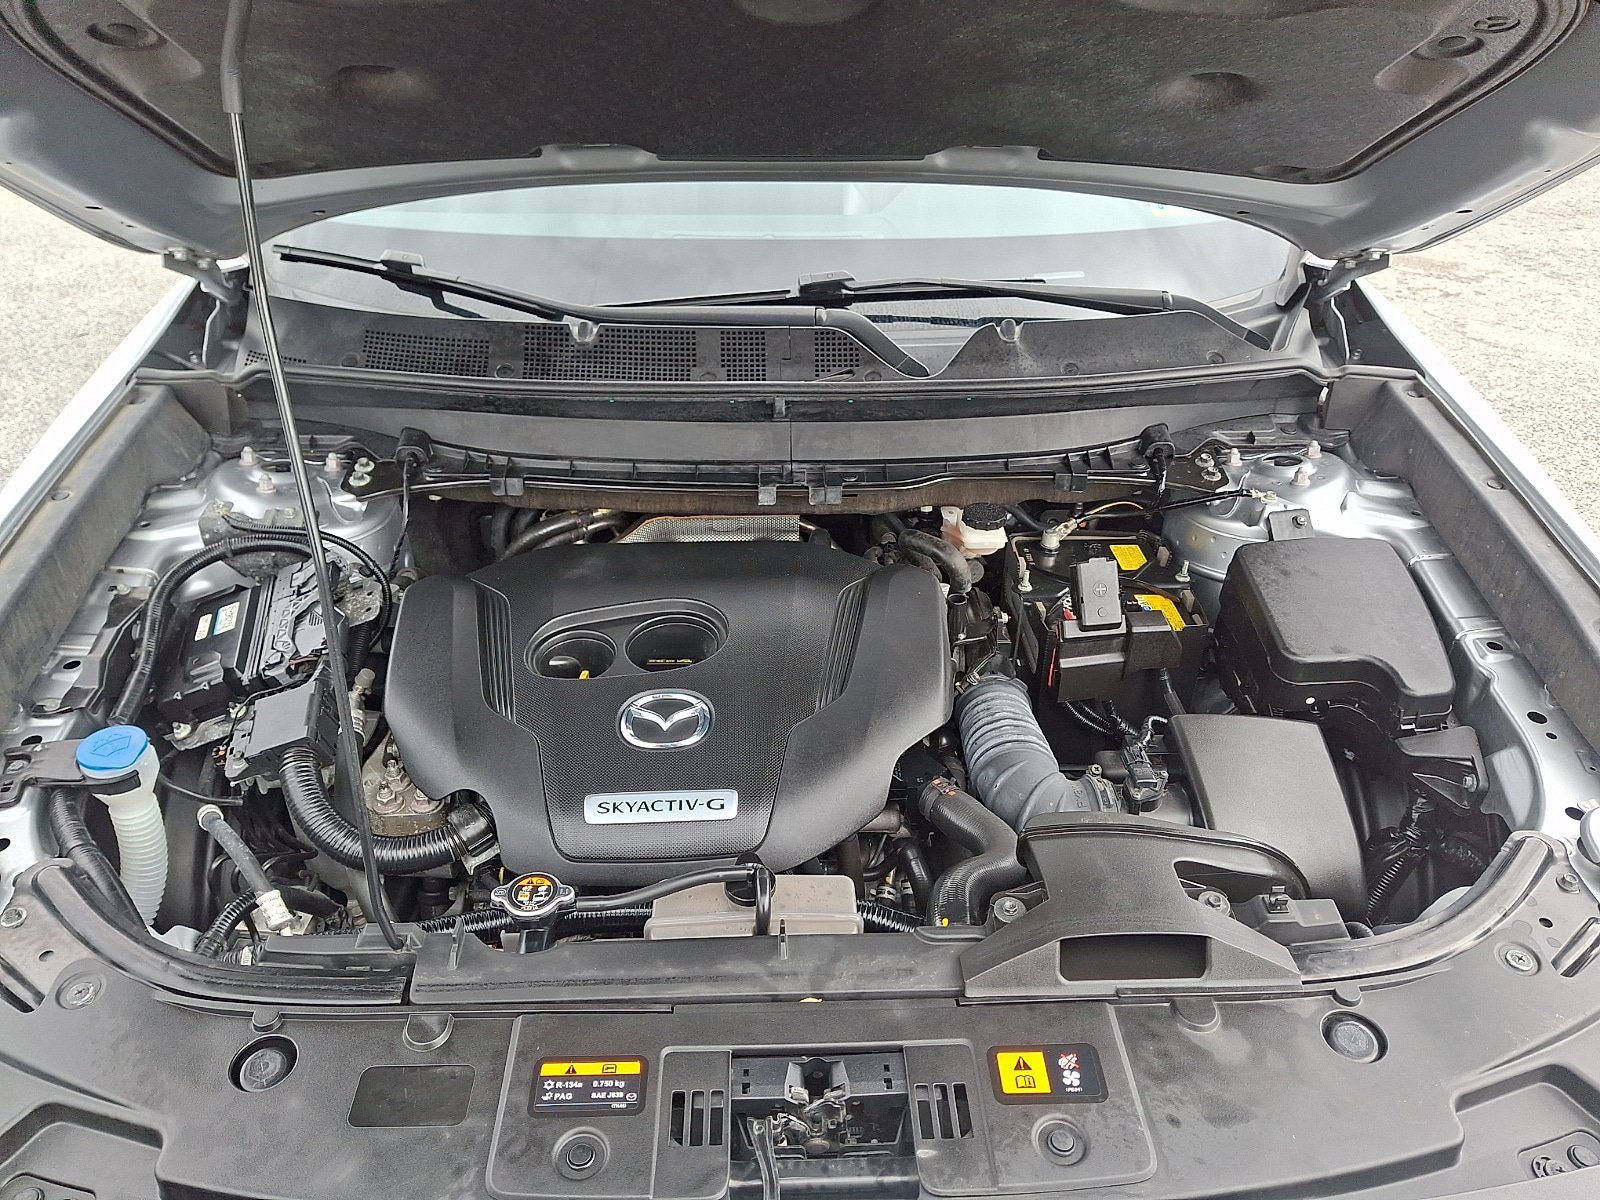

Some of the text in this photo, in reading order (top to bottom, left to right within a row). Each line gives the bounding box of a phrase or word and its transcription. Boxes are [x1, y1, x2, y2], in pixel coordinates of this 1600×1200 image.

[596, 798, 726, 815] SKYACTIV-G
[592, 1080, 614, 1088] 0.750
[614, 1079, 625, 1088] kg
[554, 1092, 573, 1100] PAG
[590, 1091, 607, 1099] SAE
